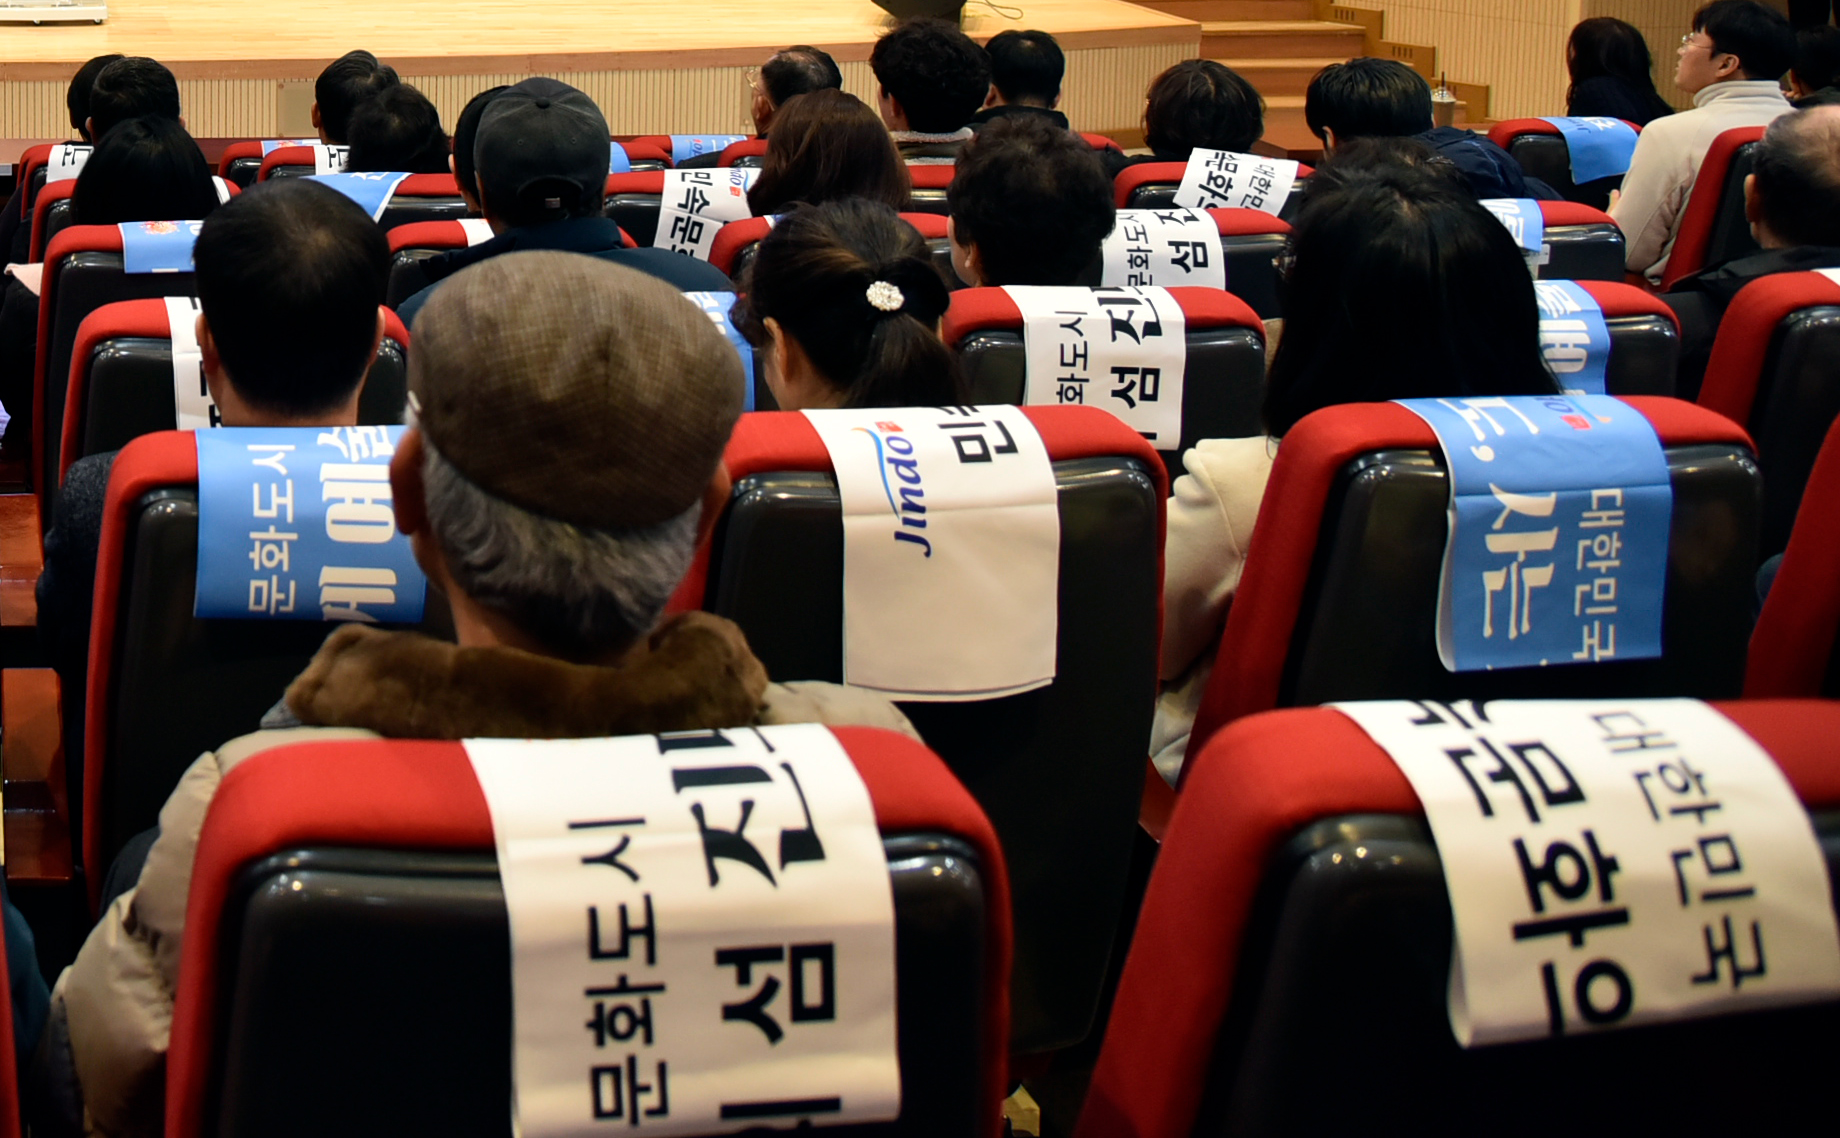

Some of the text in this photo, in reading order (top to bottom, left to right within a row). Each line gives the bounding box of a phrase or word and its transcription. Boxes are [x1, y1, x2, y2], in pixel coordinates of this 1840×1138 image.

[1111, 366, 1161, 409] 섬
[247, 444, 299, 616] 문화도시
[886, 435, 932, 558] Jindo
[1481, 483, 1559, 641] 사는
[1573, 488, 1625, 663] 대한민국
[1588, 710, 1768, 990] 대한민국
[567, 818, 670, 1127] 문화도시
[715, 942, 836, 1046] 섬
